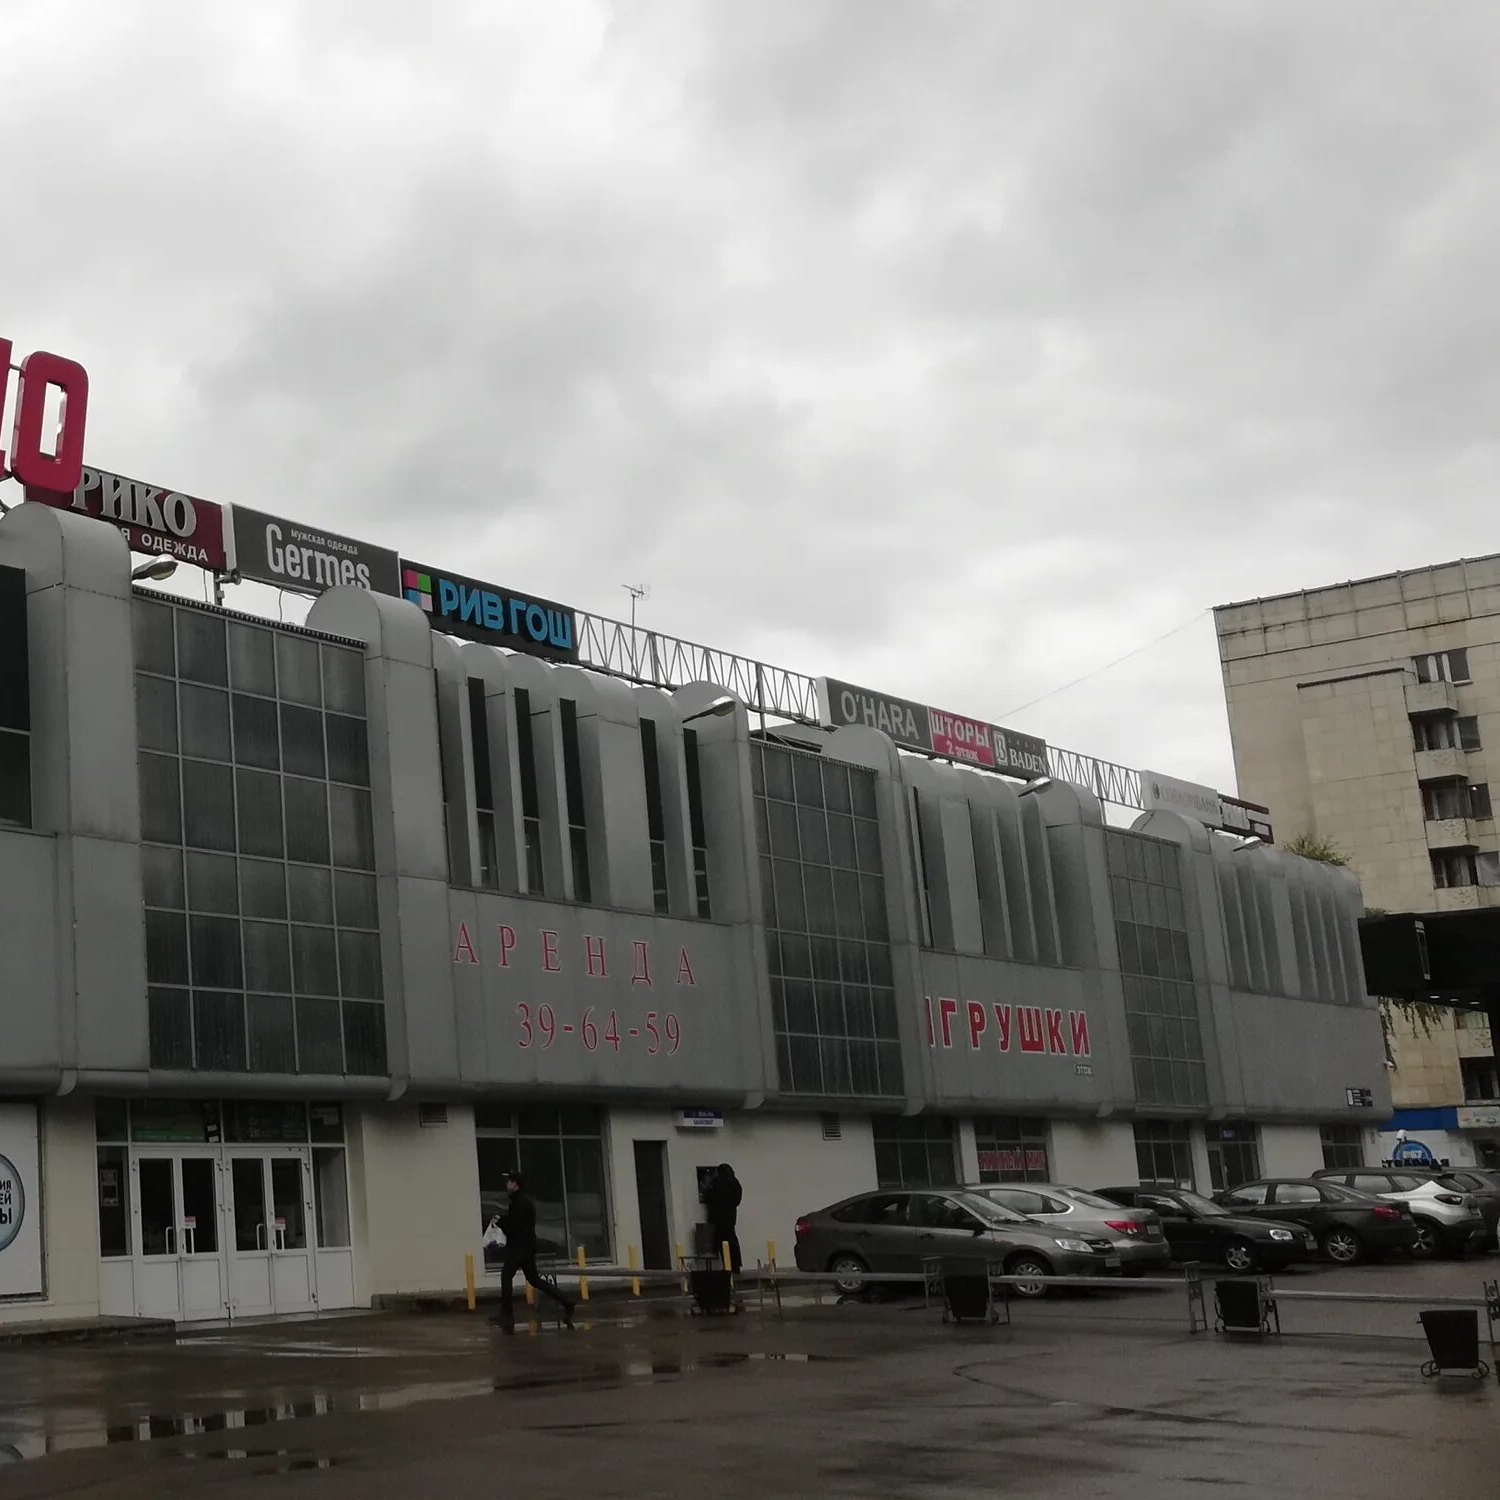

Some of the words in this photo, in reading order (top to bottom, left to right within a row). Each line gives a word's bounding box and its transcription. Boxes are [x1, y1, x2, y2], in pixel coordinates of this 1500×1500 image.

[141, 533, 209, 562] ОДЕЖДА
[266, 523, 371, 592] Germes
[439, 578, 504, 630] РИВ
[510, 597, 574, 649] ГОШ
[841, 690, 920, 740] O'HARA
[931, 711, 990, 748] ШТОРЫ
[946, 740, 954, 755] 2
[1008, 748, 1049, 775] BADEN
[453, 921, 696, 987] АРЕНДА
[517, 1002, 682, 1055] 39-64-59
